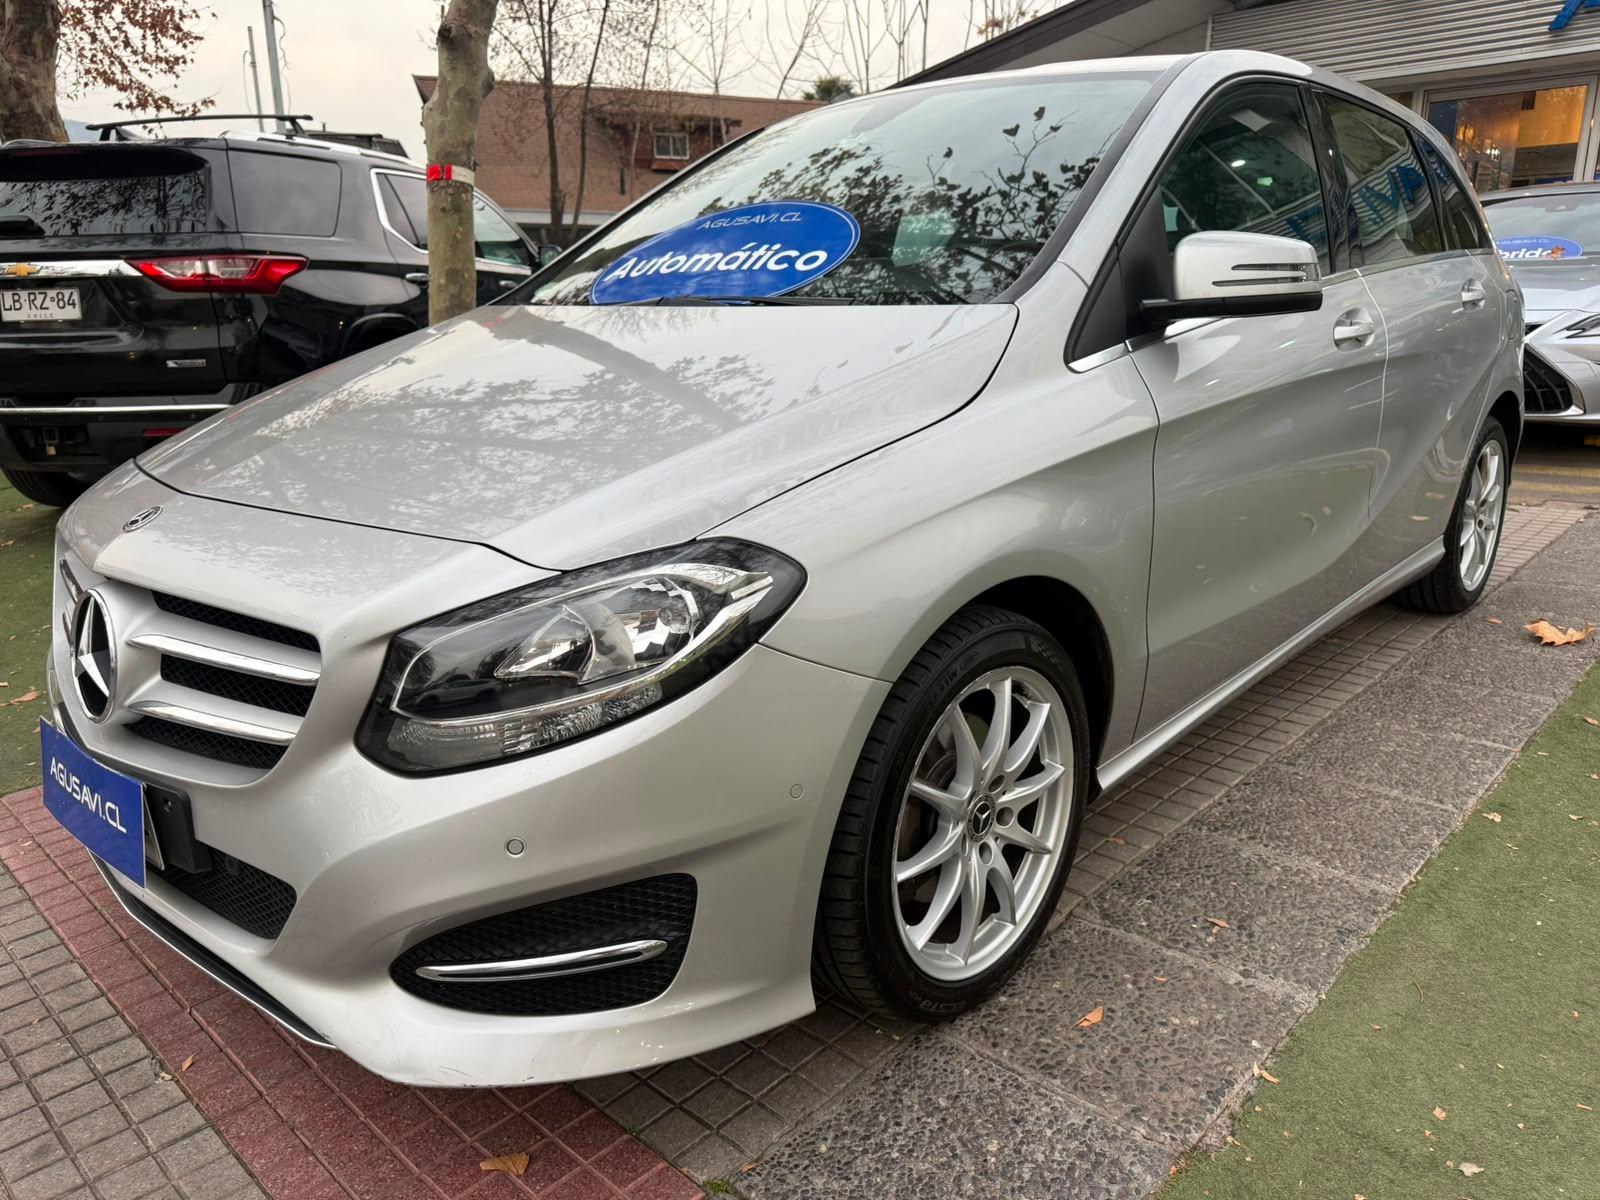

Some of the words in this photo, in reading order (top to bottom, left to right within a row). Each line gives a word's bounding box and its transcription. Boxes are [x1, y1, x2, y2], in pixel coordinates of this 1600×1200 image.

[697, 212, 802, 230] AGUSAVI.CL
[603, 242, 828, 282] Automático
[50, 756, 128, 834] AGUSAVI.CL
